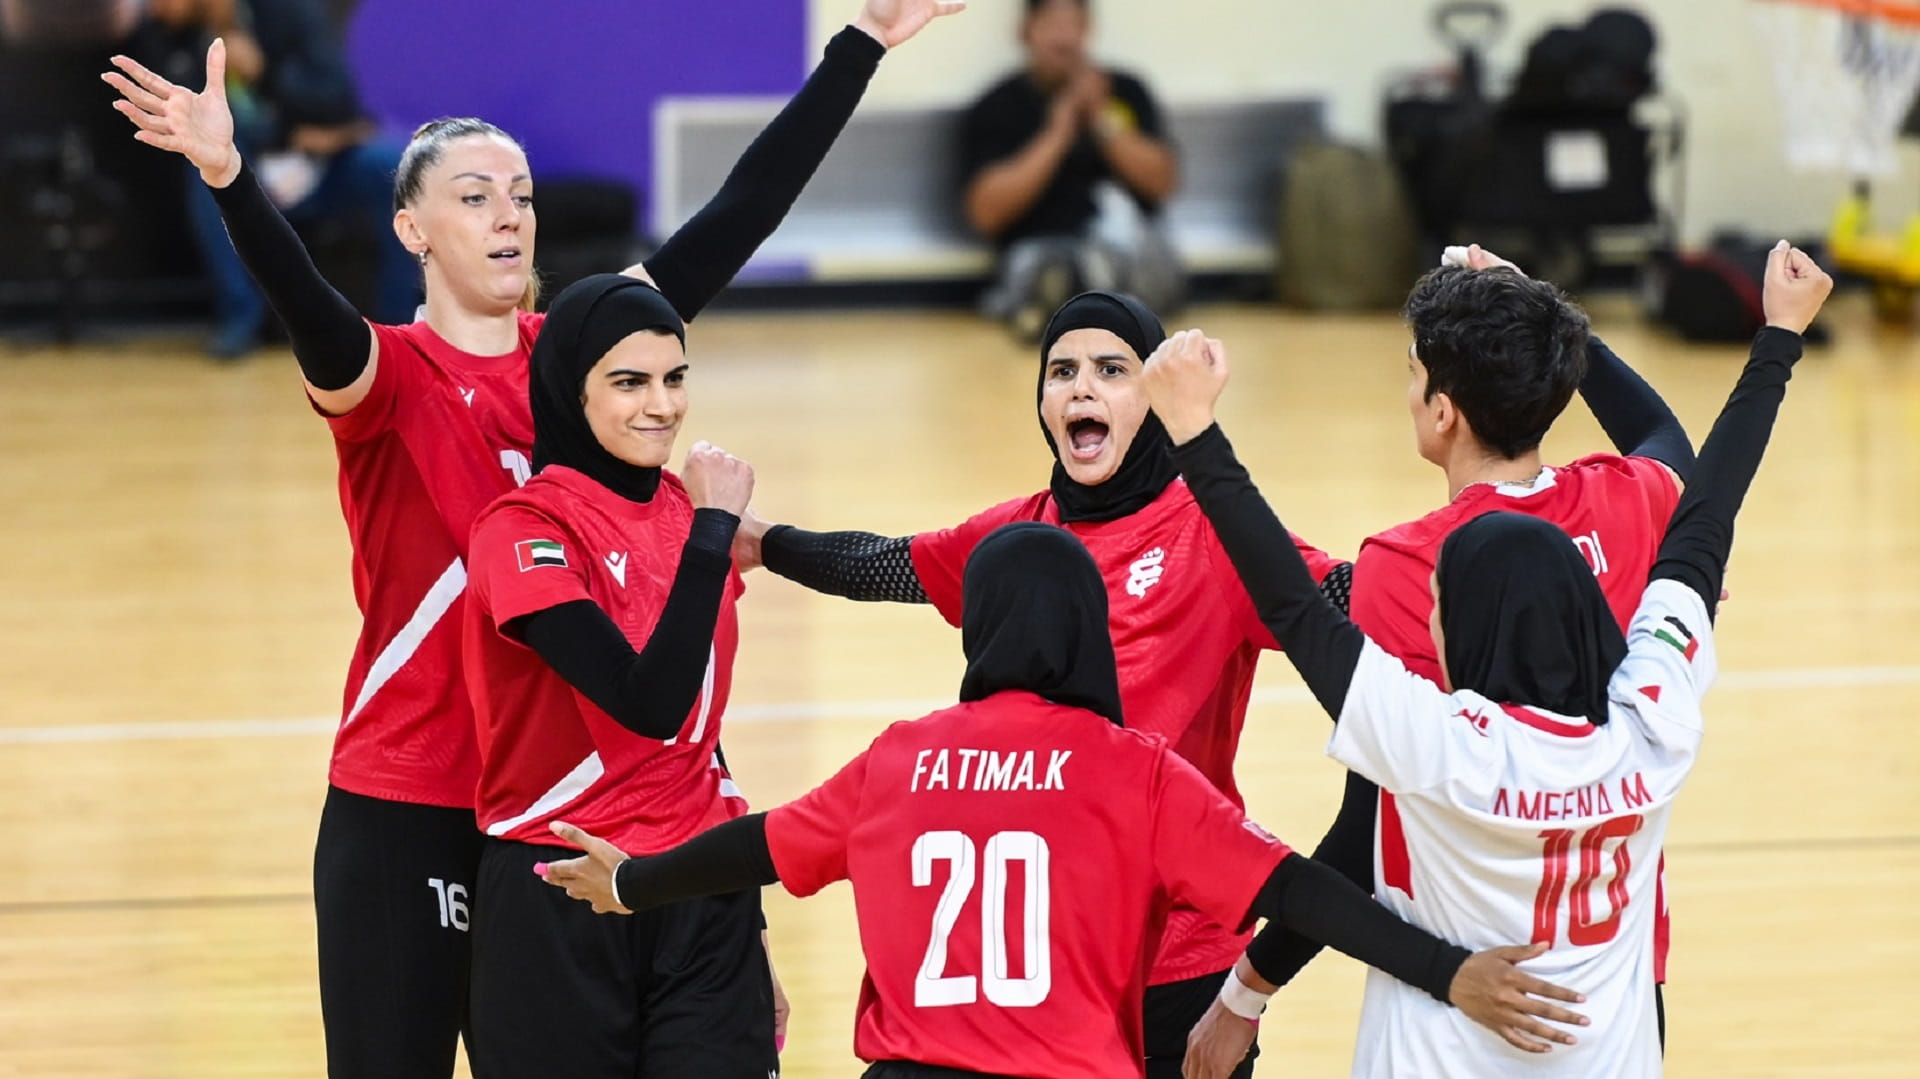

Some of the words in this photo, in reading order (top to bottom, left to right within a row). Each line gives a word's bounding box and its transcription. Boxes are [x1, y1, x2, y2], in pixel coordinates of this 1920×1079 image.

[910, 748, 1073, 793] FATIMA.K
[428, 877, 470, 933] 16
[911, 830, 1051, 1008] 20
[1530, 813, 1644, 950] 10
